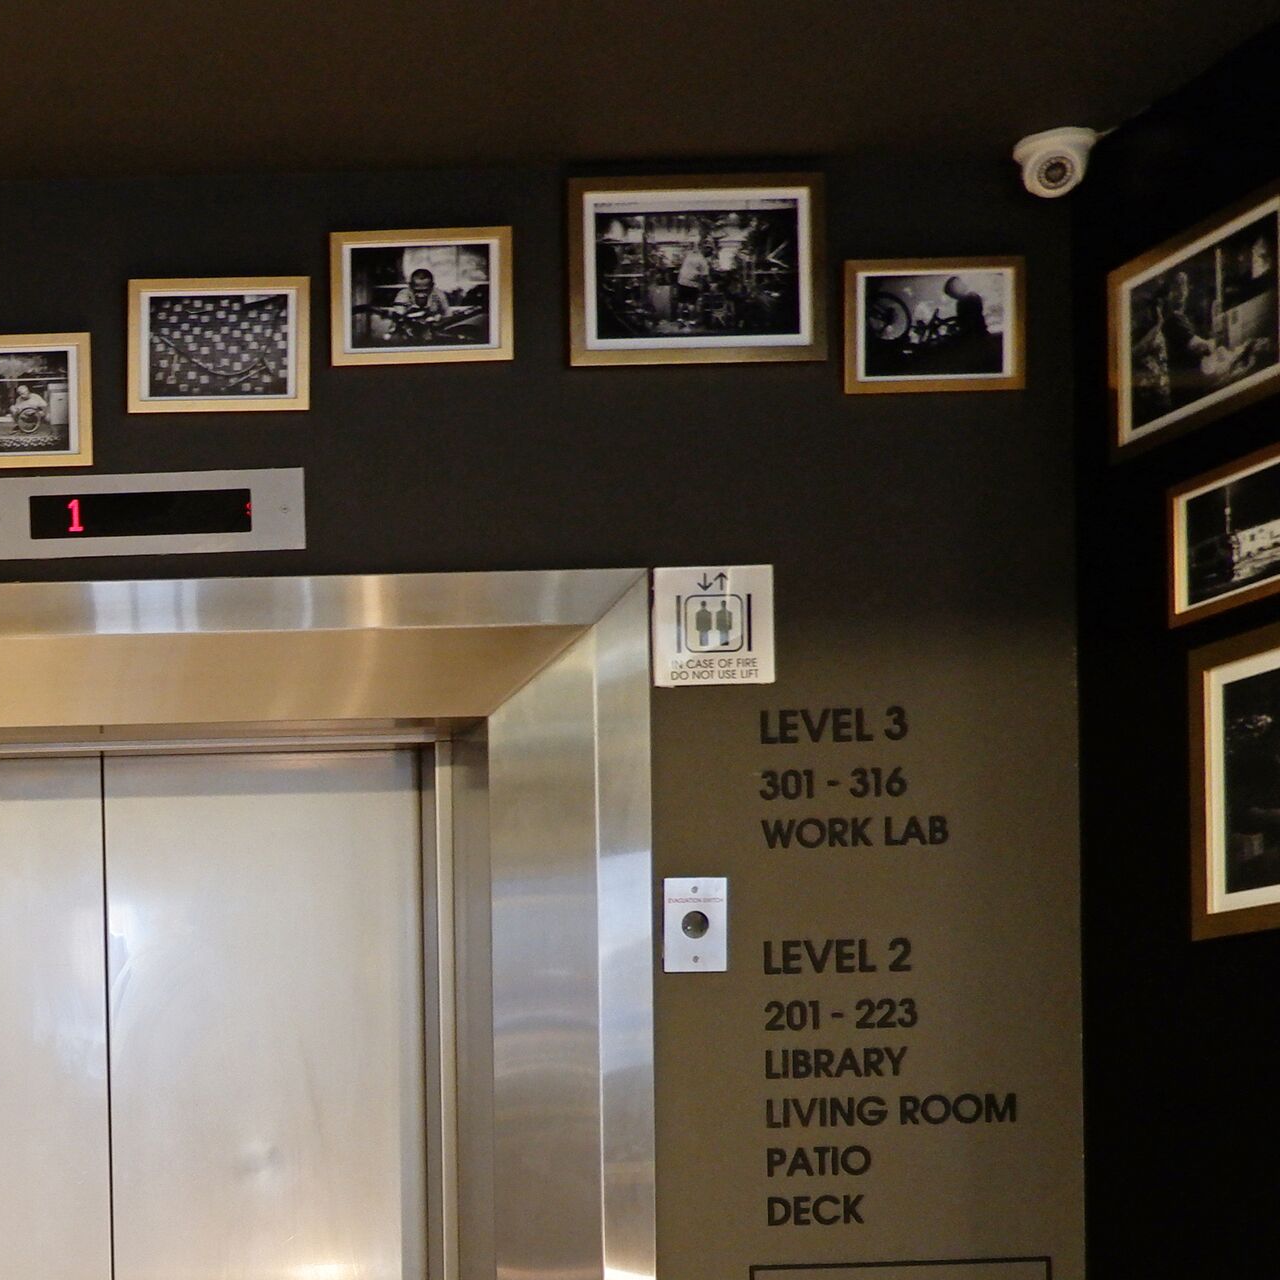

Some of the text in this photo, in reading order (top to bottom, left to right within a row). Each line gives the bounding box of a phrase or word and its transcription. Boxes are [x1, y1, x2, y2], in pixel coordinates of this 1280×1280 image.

[68, 499, 83, 532] 1
[671, 658, 757, 670] IN CASE OF FIRE
[671, 669, 759, 680] DO NOT USE LIFT
[760, 705, 908, 745] LEVEL 3
[759, 767, 907, 801] 301 316
[761, 815, 949, 849] WORK LAB
[764, 937, 912, 975] LEVEL 2
[765, 998, 918, 1031] 201 223
[766, 1046, 907, 1080] LIBRARY
[766, 1093, 1017, 1128] LIVING ROOM
[767, 1145, 871, 1177] PATIO
[768, 1195, 864, 1226] DECK
